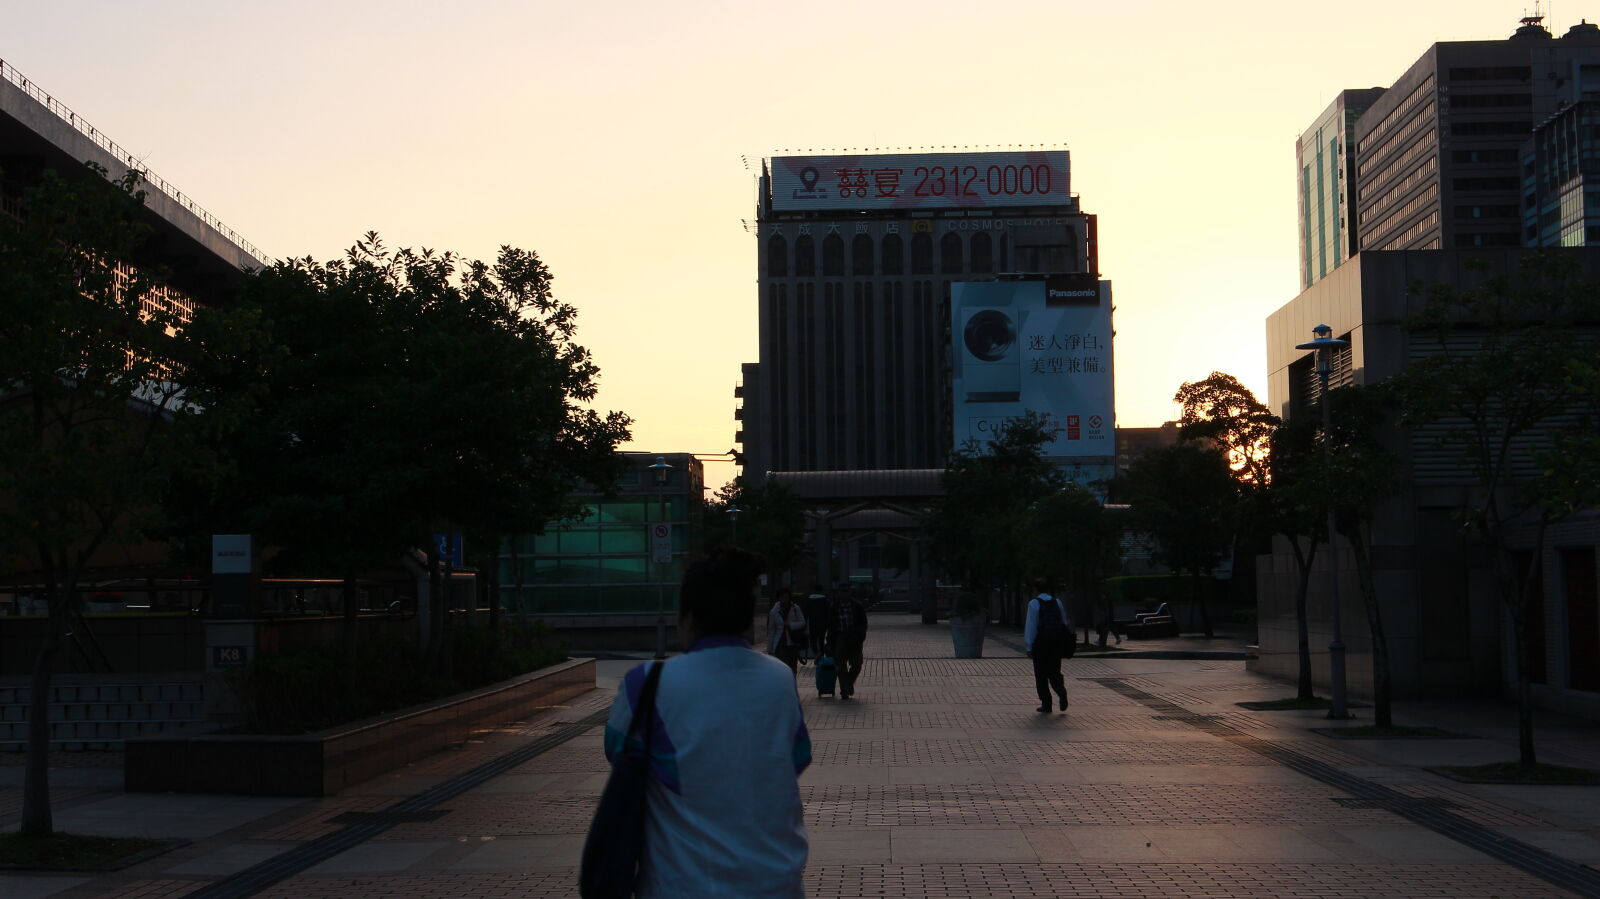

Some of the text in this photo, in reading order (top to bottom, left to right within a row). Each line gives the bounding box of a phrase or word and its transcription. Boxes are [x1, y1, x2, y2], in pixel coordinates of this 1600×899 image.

[914, 164, 1051, 197] 2312-0000
[771, 222, 899, 235] 天成大飯店
[948, 218, 1014, 231] COSMOS
[1049, 289, 1096, 297] Panasonic
[220, 647, 240, 661] K8
